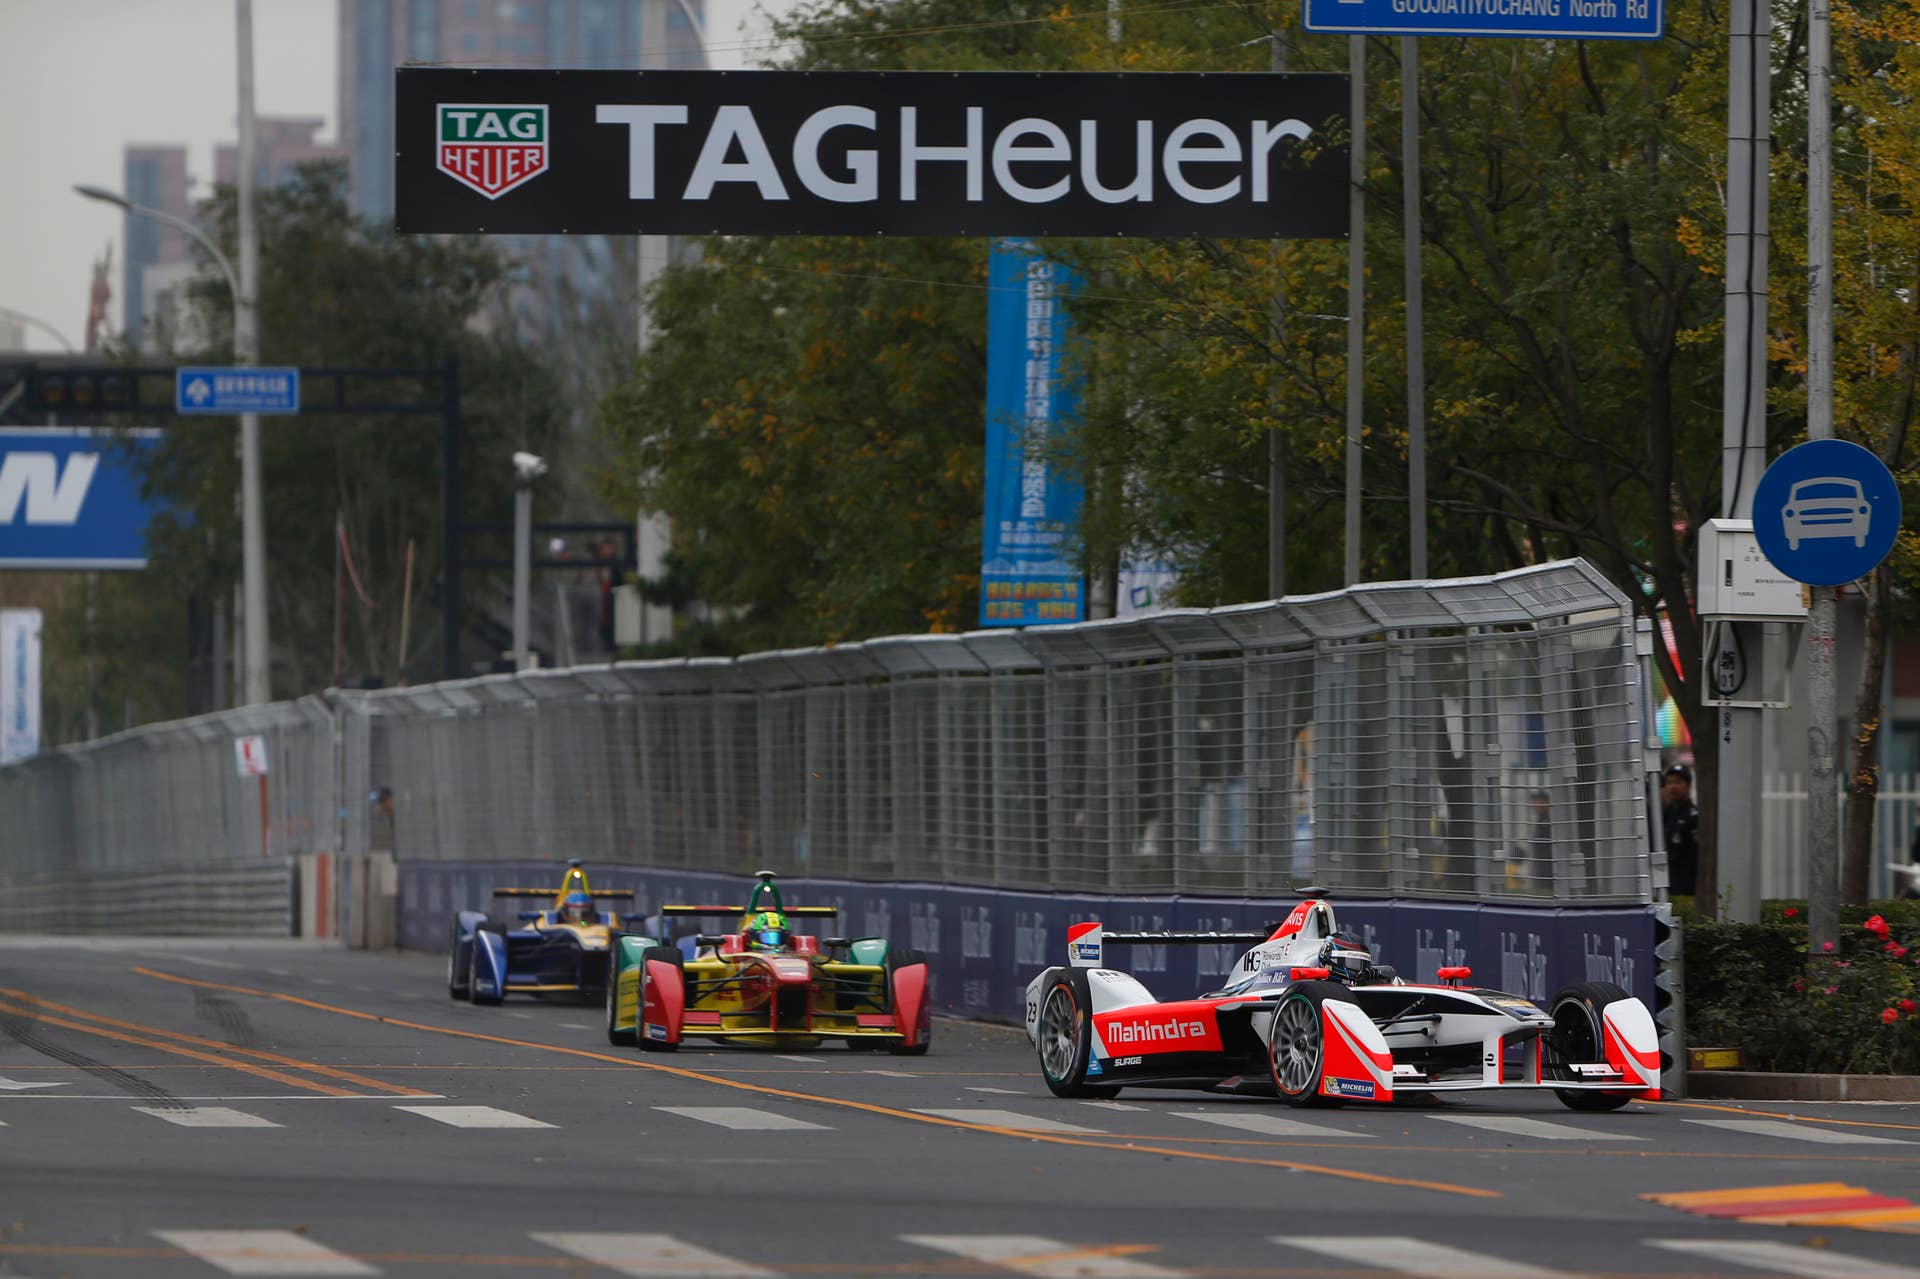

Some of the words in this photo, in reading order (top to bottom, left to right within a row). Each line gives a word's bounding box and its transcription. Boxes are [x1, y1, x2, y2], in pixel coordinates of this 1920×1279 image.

[1569, 0, 1616, 18] North
[1625, 0, 1649, 19] Rd
[447, 111, 537, 139] TAG
[444, 147, 541, 191] HEUER
[1287, 912, 1304, 927] AVIS
[1243, 951, 1261, 972] IHG
[1027, 1002, 1037, 1023] 23
[1108, 1018, 1207, 1043] Mahindra
[1114, 1056, 1143, 1067] SURGE
[1341, 1083, 1374, 1092] MICHELIN
